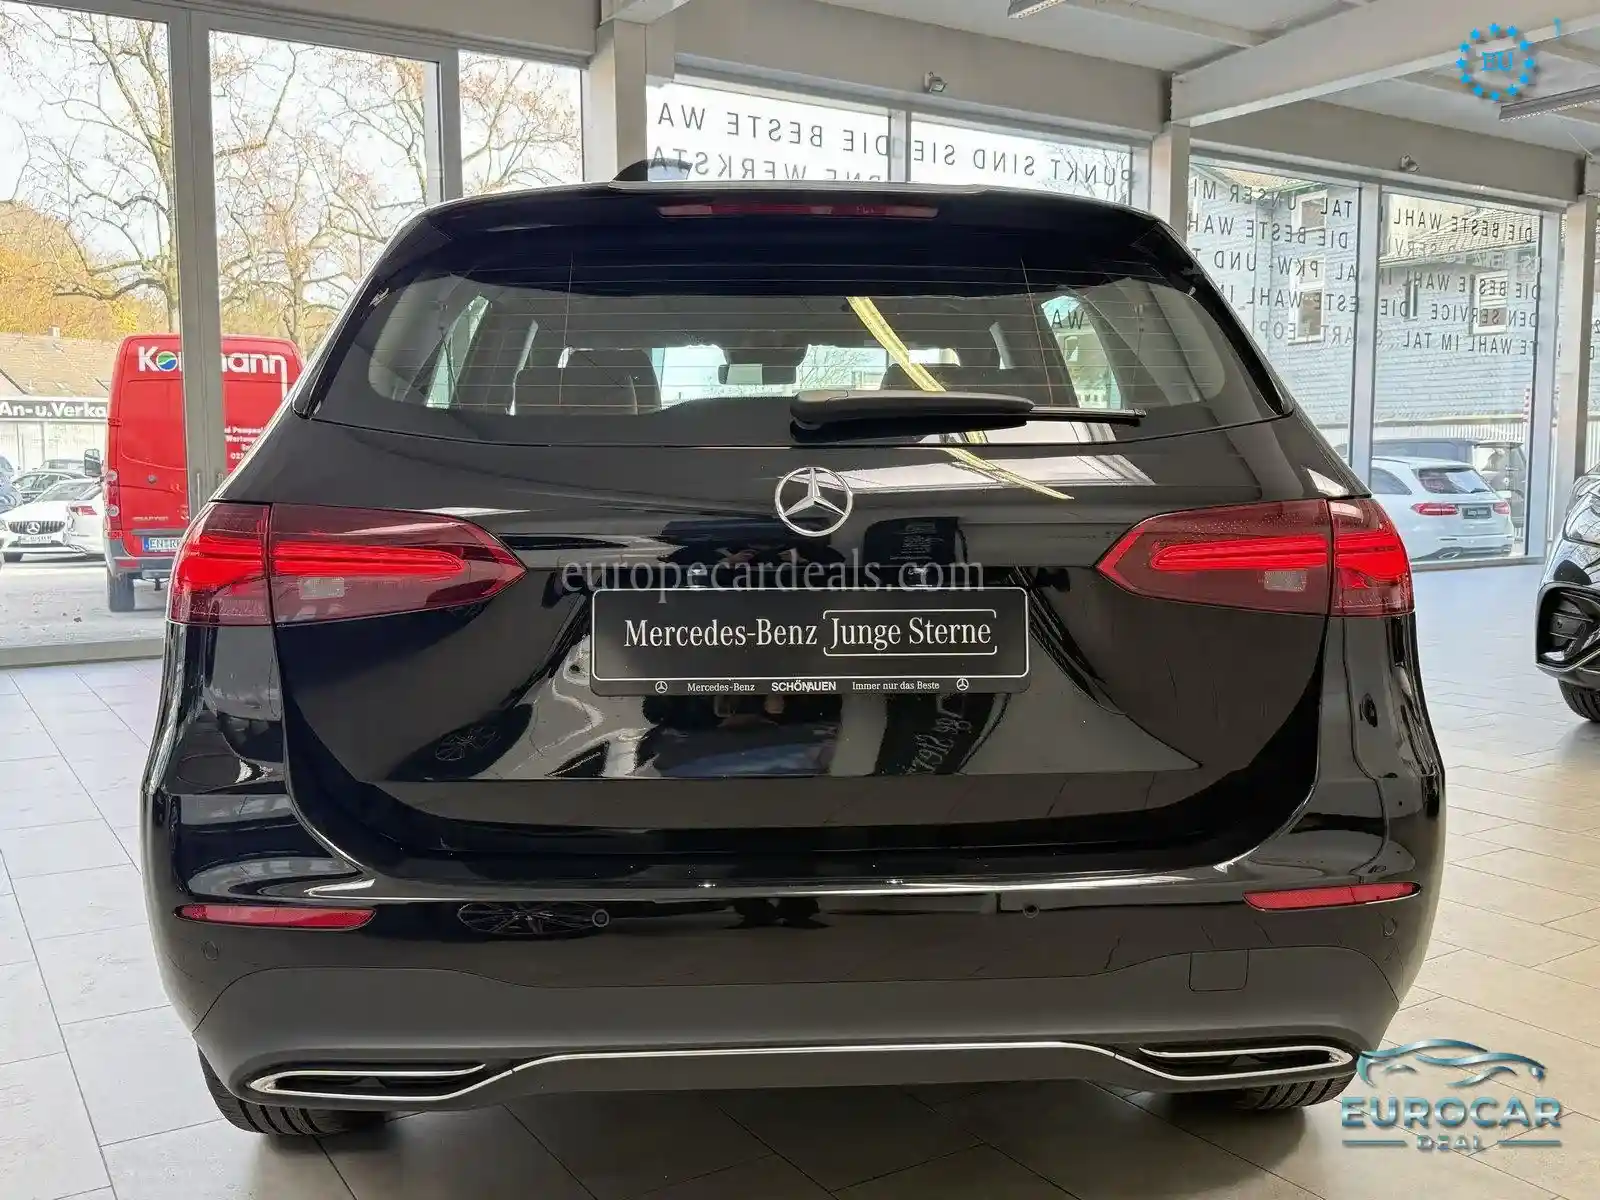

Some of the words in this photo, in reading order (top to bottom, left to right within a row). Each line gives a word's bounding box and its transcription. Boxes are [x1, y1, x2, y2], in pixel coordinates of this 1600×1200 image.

[138, 346, 289, 388] Koann
[623, 618, 818, 647] Mercedes-Benz
[829, 617, 902, 651] Junge
[908, 616, 992, 645] Sterne
[687, 682, 756, 692] Mercedes-Benz
[852, 681, 881, 691] Immer
[882, 683, 899, 691] nur
[899, 681, 916, 691] das
[916, 680, 941, 691] Beste
